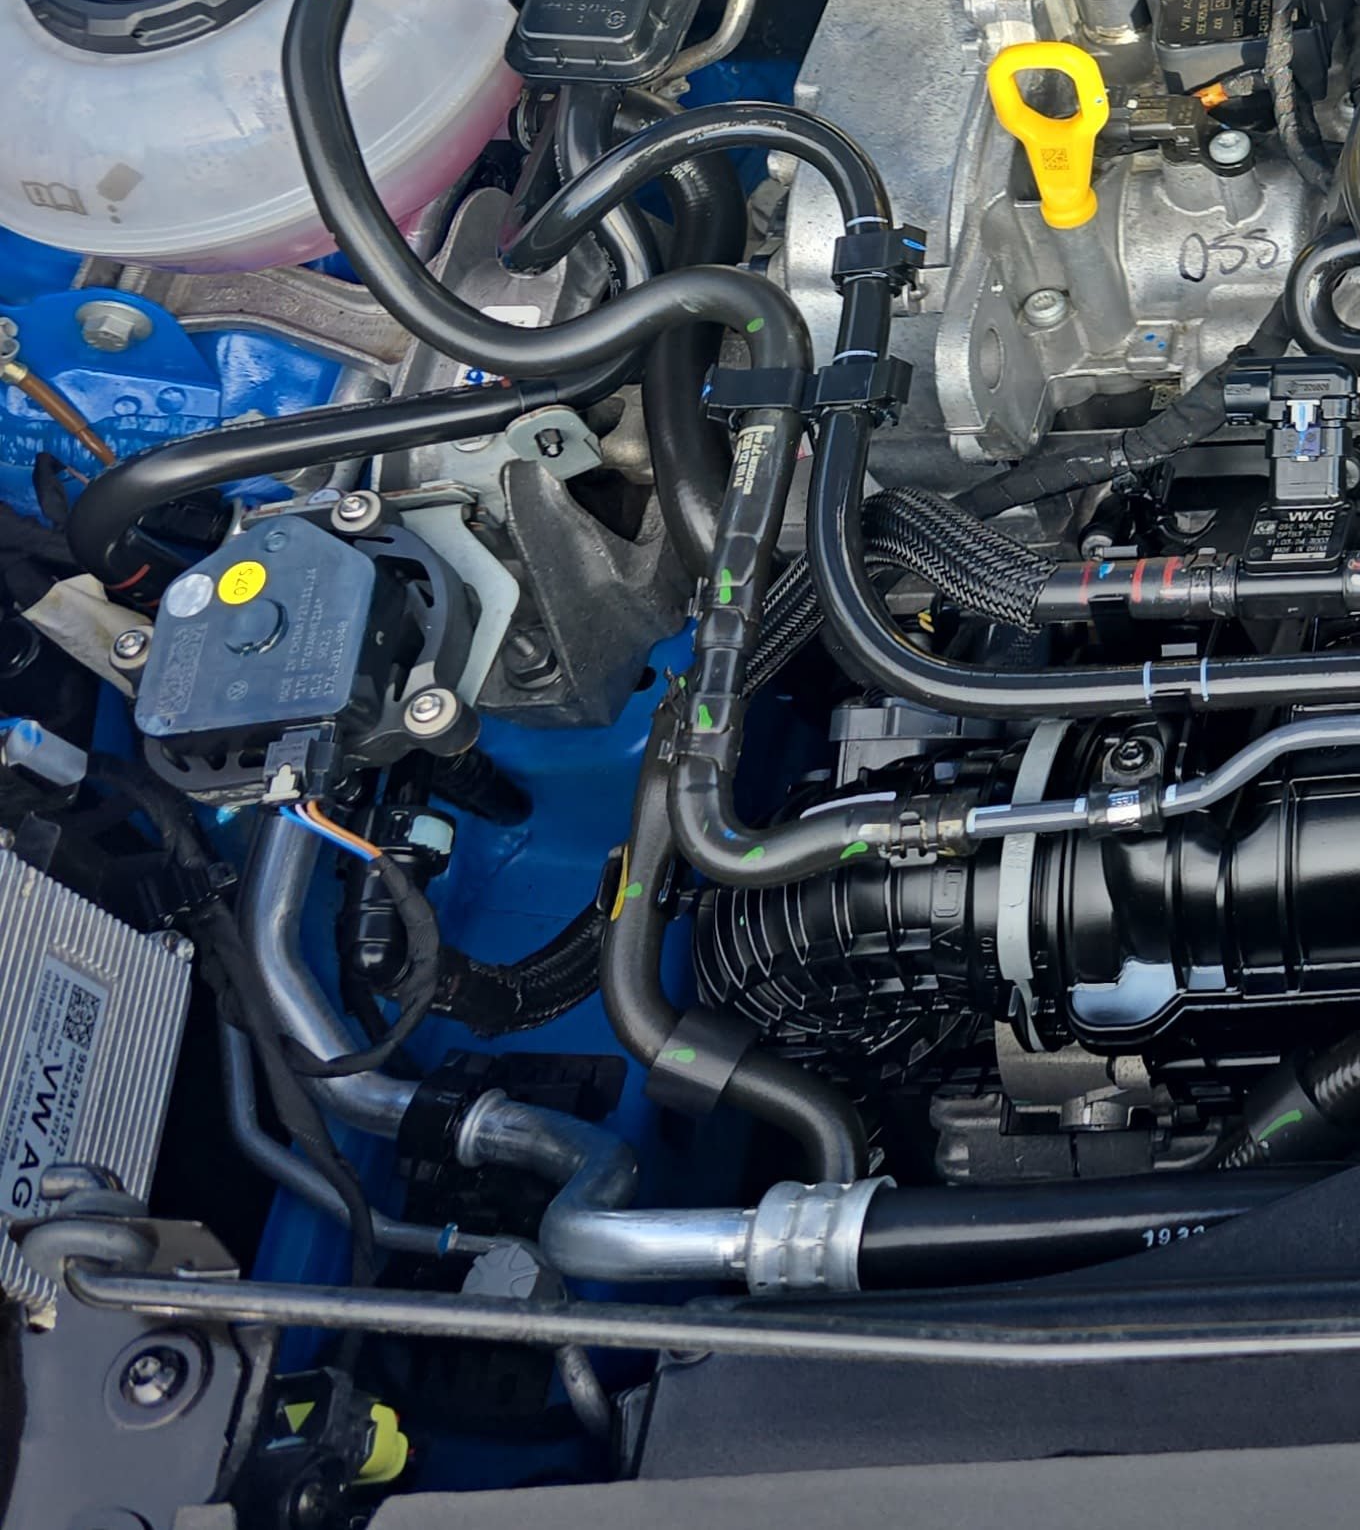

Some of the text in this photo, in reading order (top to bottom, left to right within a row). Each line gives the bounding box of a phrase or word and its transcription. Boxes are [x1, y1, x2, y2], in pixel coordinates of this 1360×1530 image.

[1288, 510, 1336, 521] VW AG
[31, 1066, 62, 1136] VW
[11, 1142, 40, 1209] AG
